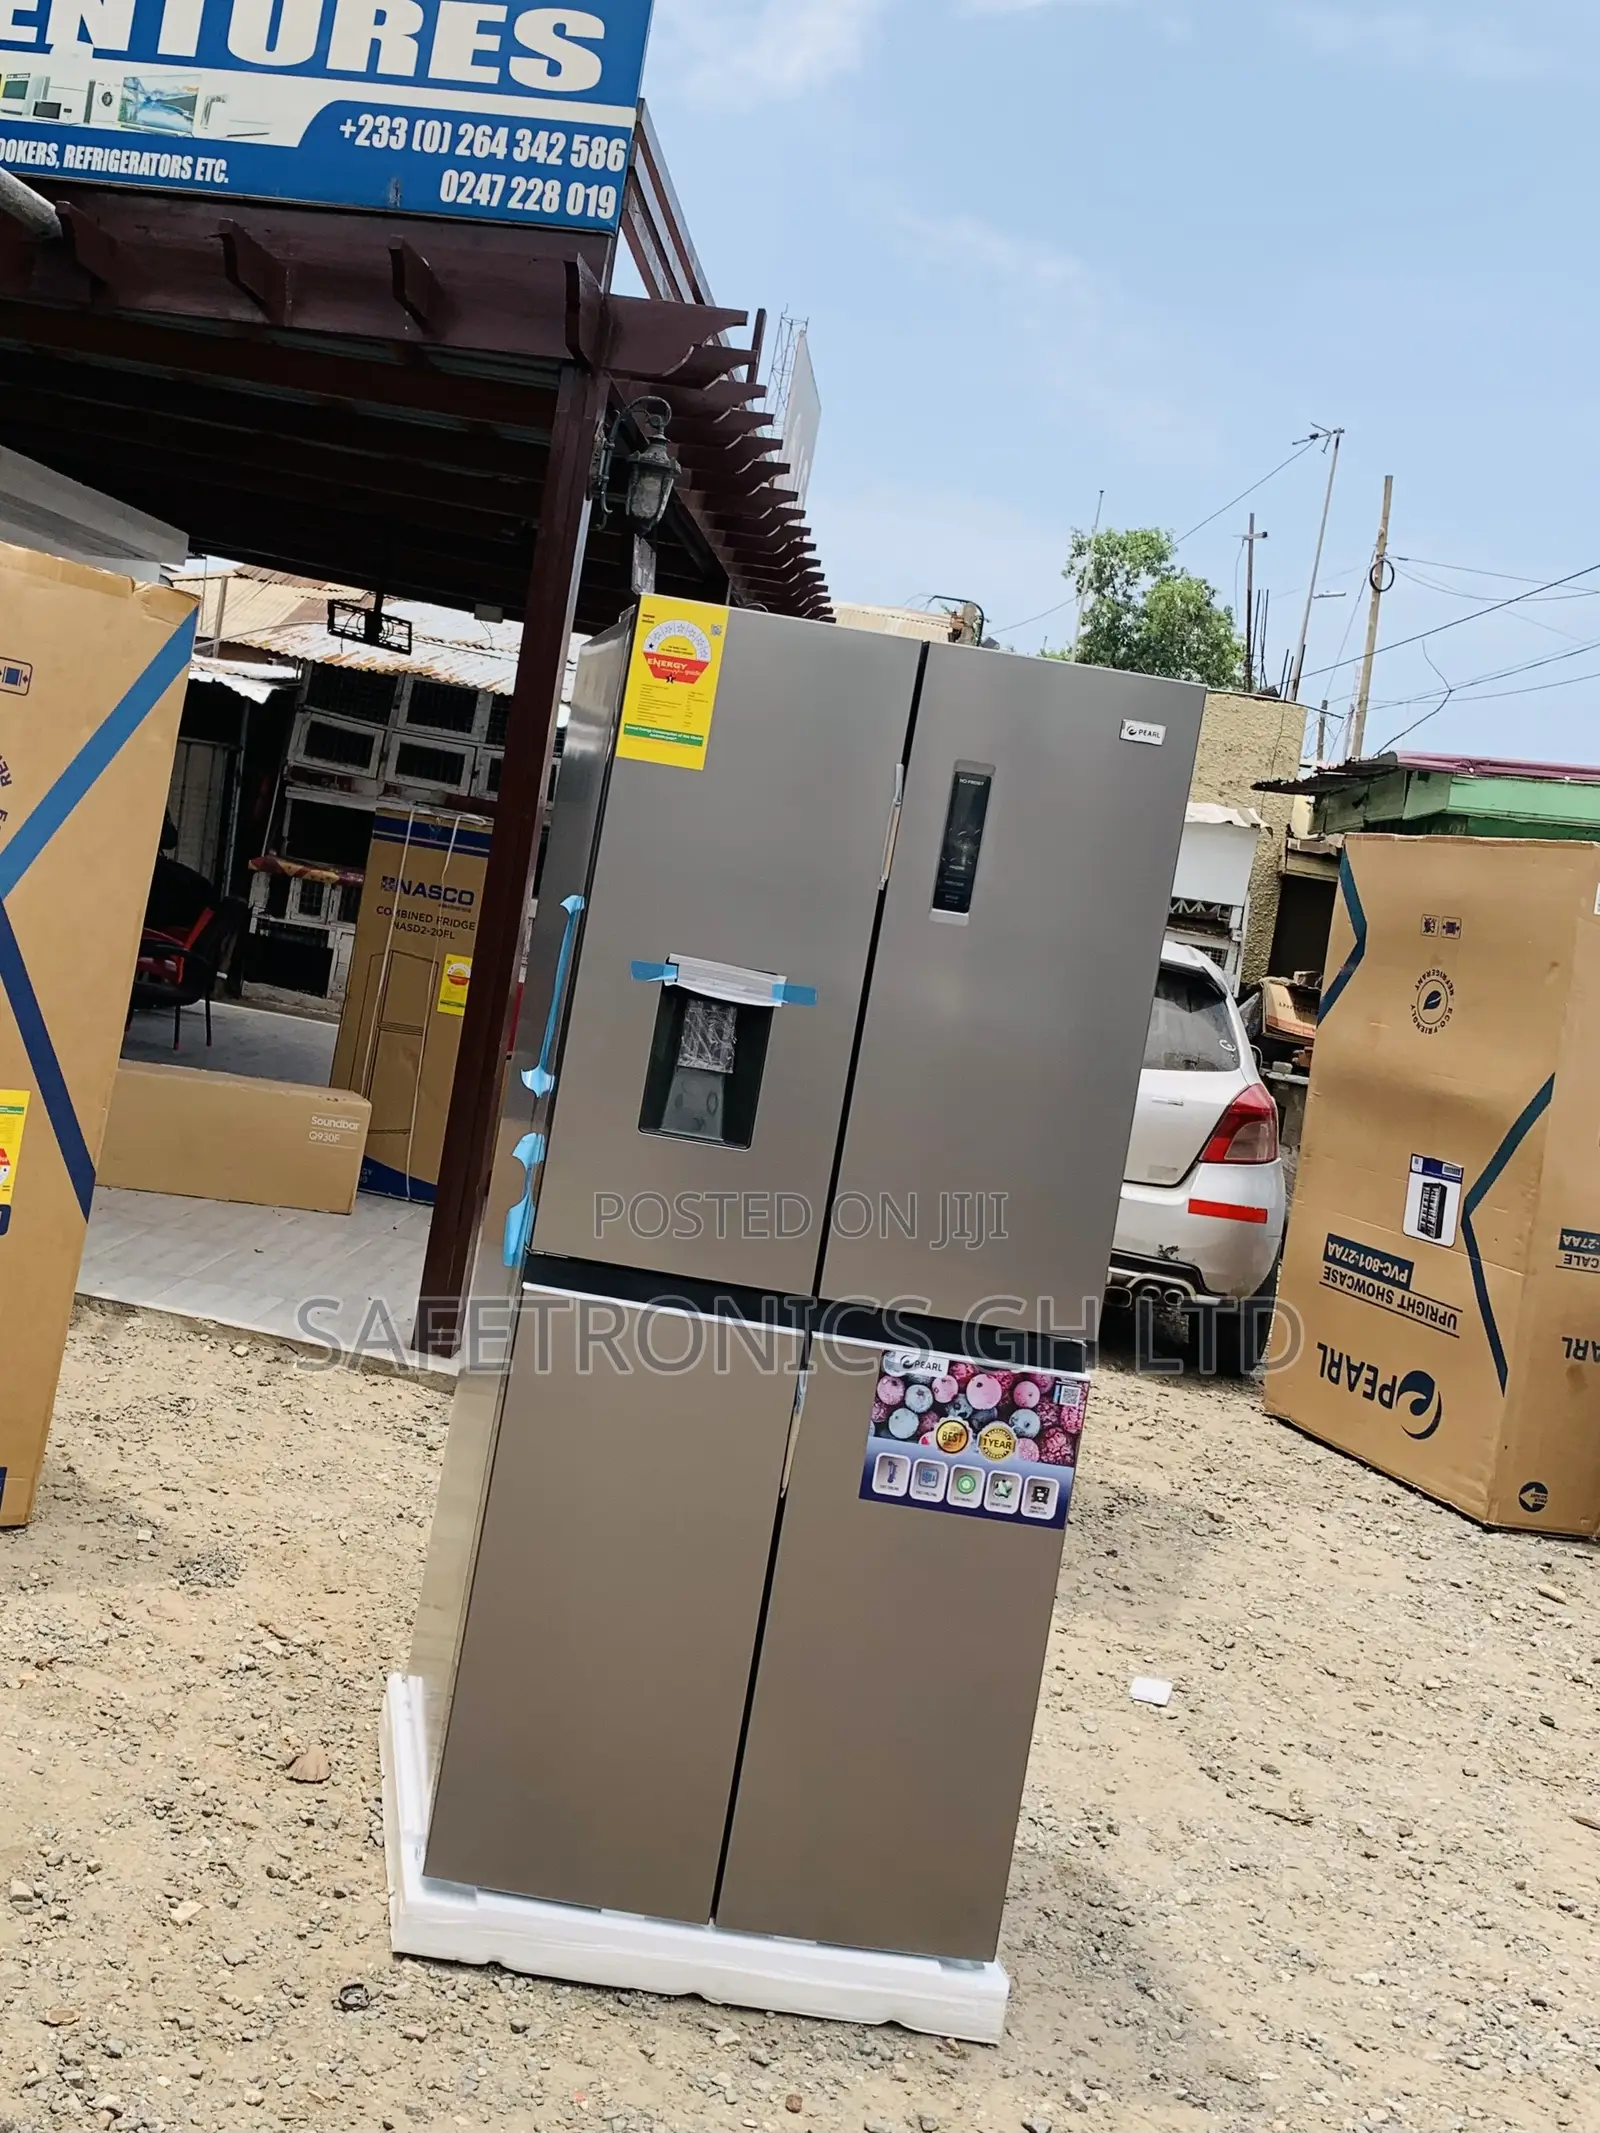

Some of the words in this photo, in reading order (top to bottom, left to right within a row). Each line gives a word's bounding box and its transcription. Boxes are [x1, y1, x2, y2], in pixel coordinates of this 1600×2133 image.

[0, 0, 605, 92] NTURES
[339, 114, 408, 150] +233
[455, 123, 509, 161] 264
[512, 128, 566, 166] 342
[569, 135, 627, 172] 586
[62, 144, 193, 180] REFRIGERATORS
[194, 156, 229, 183] ETC.
[440, 169, 506, 207] 0247
[507, 176, 561, 213] 228
[566, 182, 617, 220] 019
[1138, 729, 1161, 739] PEARL
[394, 879, 474, 906] NASCO
[436, 915, 476, 931] FRIDGE
[1415, 969, 1454, 996] REFRIGERANT
[1410, 1004, 1453, 1035] ECO-FRIENDLY
[311, 1116, 360, 1130] Soundbar
[1328, 1241, 1410, 1284] PVC-801-27AA
[1323, 1265, 1395, 1305] SHOWCASE
[1397, 1294, 1458, 1331] UPRIGHT
[914, 1360, 942, 1372] PEARL
[1317, 1341, 1397, 1409] PEARL
[942, 1430, 964, 1443] BEST
[988, 1439, 1012, 1450] YEAR
